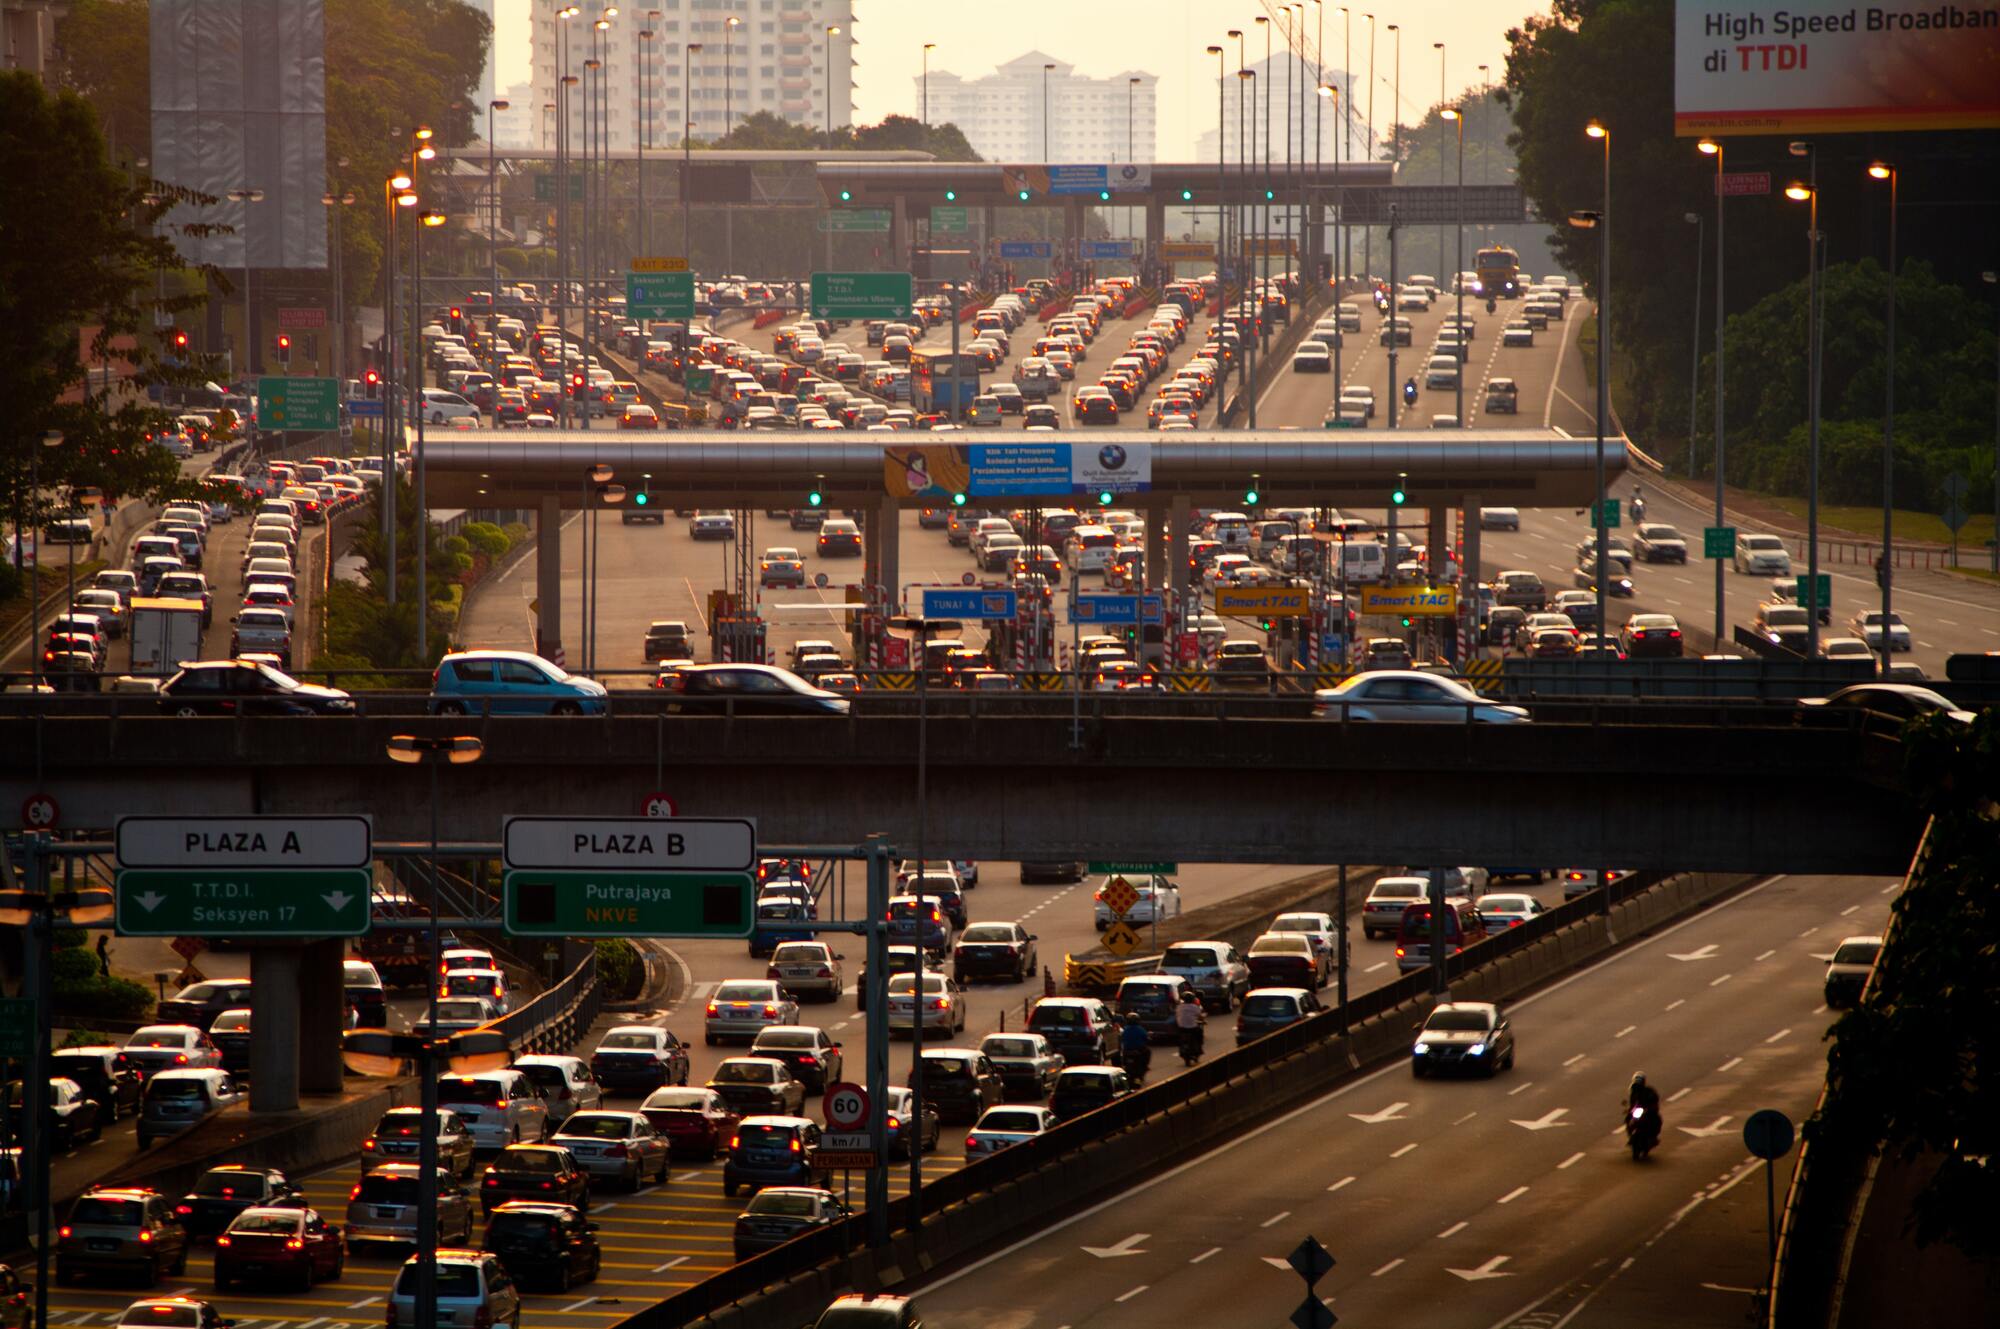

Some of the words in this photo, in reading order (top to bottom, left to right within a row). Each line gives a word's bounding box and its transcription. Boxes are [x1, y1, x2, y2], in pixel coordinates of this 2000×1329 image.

[1705, 13, 1763, 40] High
[1774, 10, 1855, 38] Speed
[1866, 6, 1998, 32] Broadban
[1704, 50, 1726, 72] di
[1736, 44, 1807, 72] TTDI
[1687, 117, 1783, 130] www.tm.com.my
[933, 600, 962, 609] TUNAI
[968, 600, 975, 609] &
[186, 833, 267, 852] PLAZA
[281, 831, 301, 854] A
[574, 834, 654, 854] PLAZA
[667, 833, 685, 856] B
[586, 884, 671, 902] Putrajaya
[193, 906, 269, 924] Seksyen
[279, 906, 296, 921] 17
[586, 907, 638, 923] NKVE
[834, 1098, 859, 1114] 60
